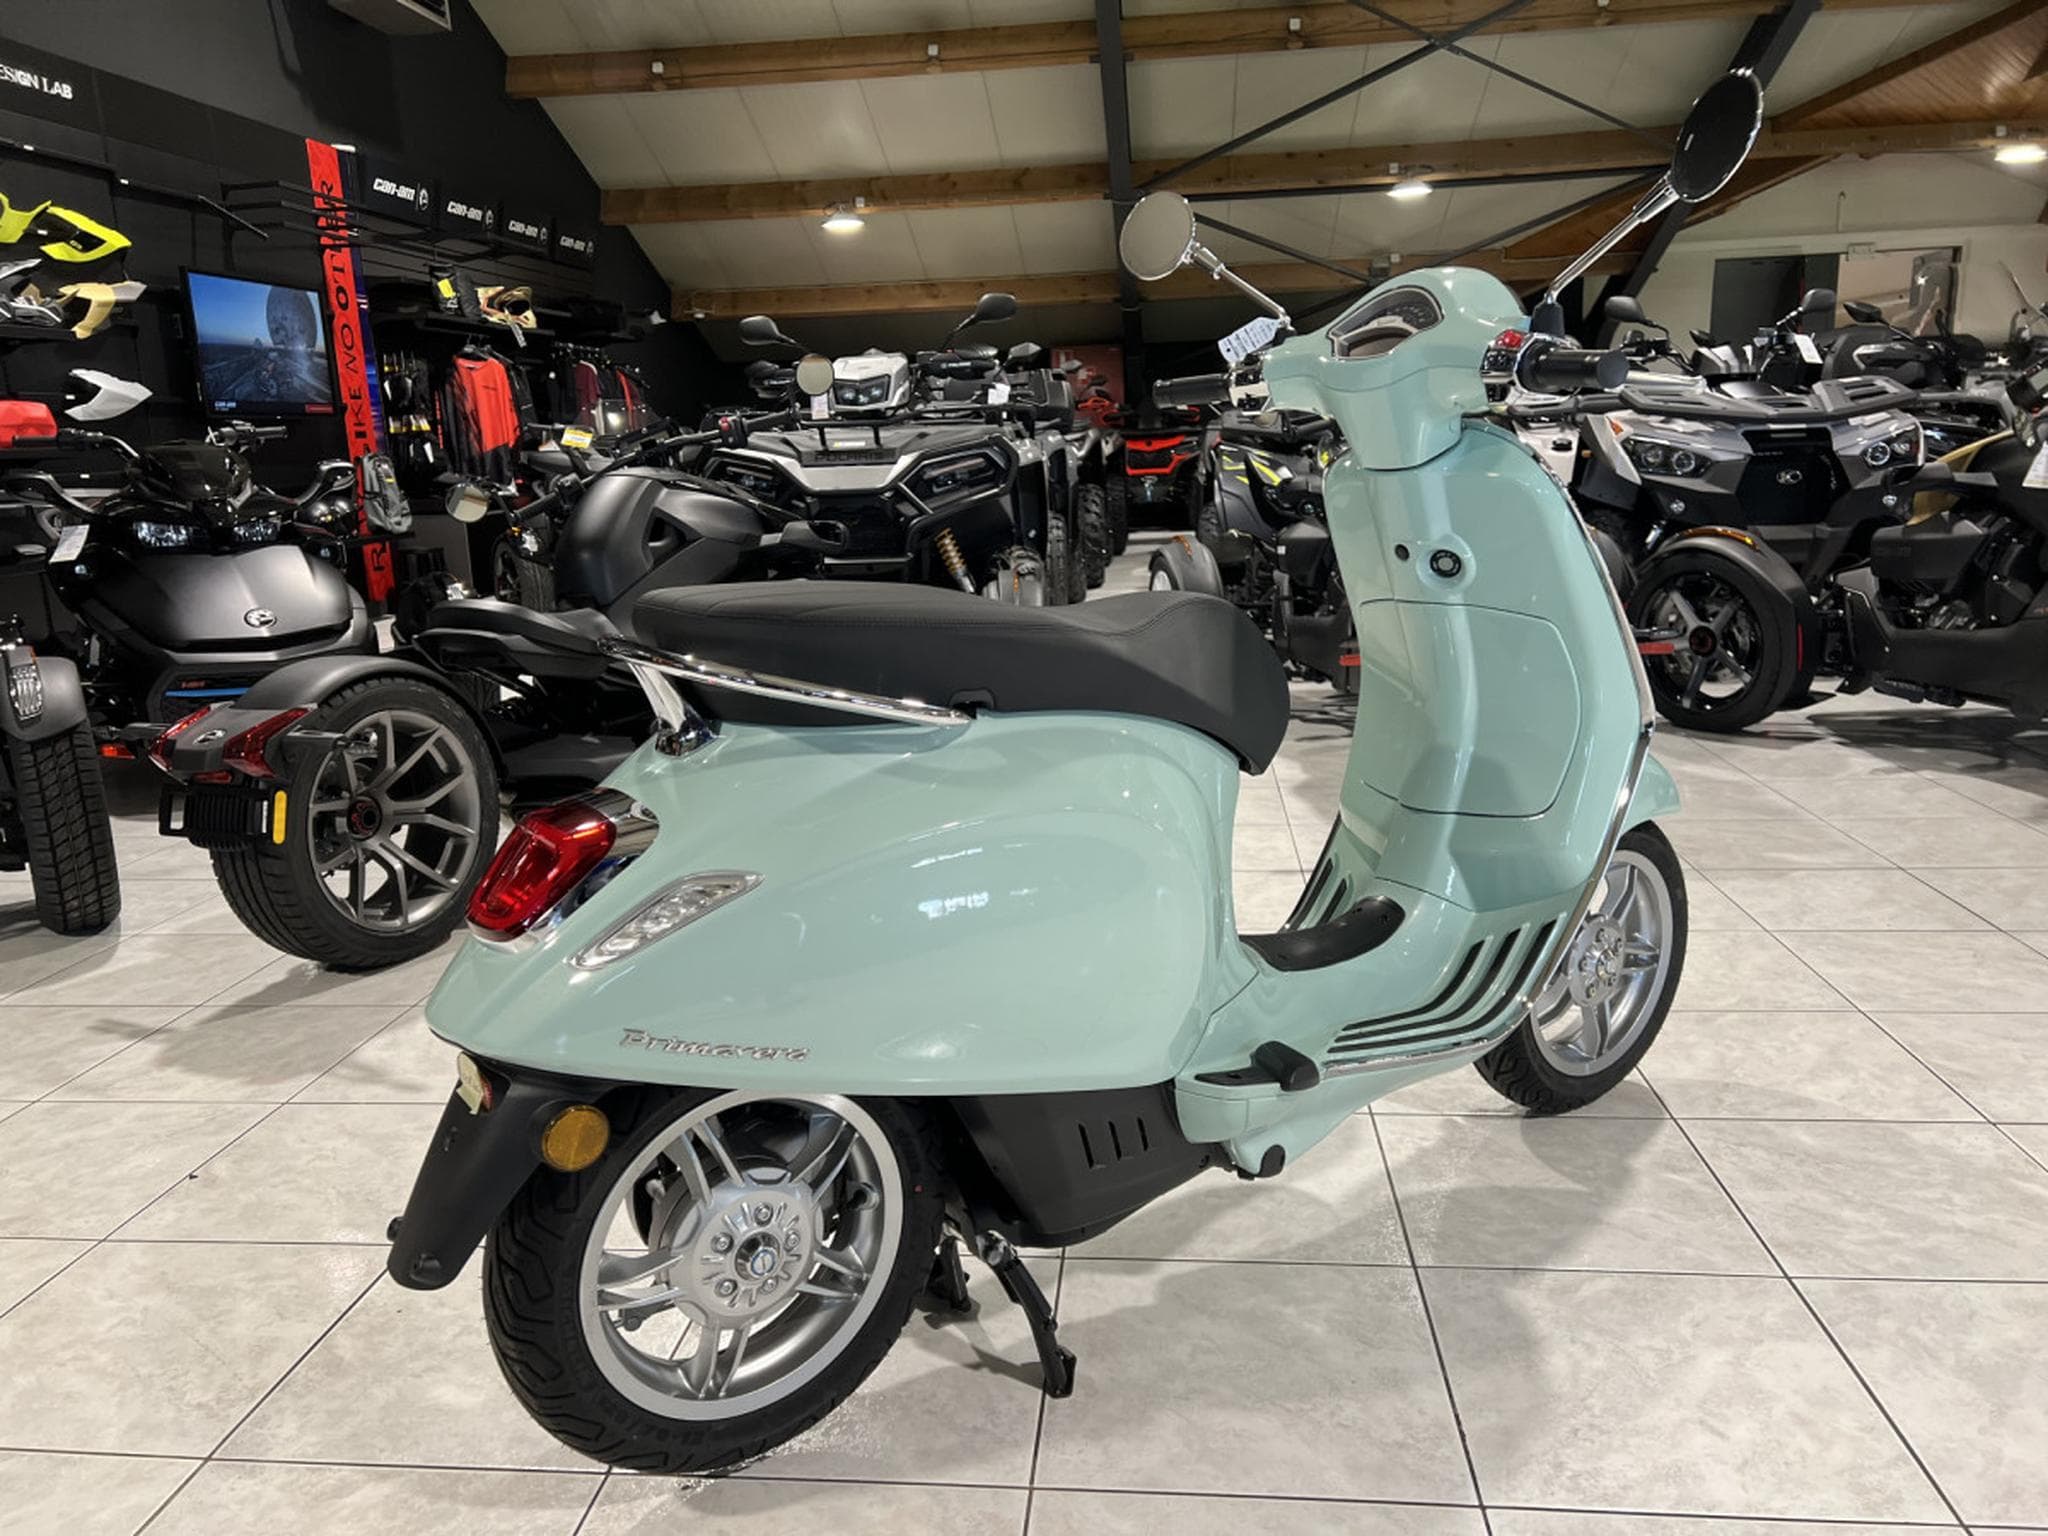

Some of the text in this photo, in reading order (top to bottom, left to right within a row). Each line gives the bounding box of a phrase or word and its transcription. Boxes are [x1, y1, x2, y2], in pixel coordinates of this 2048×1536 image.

[41, 76, 74, 100] LAB
[341, 323, 358, 374] NO
[619, 1027, 810, 1061] Primavera
